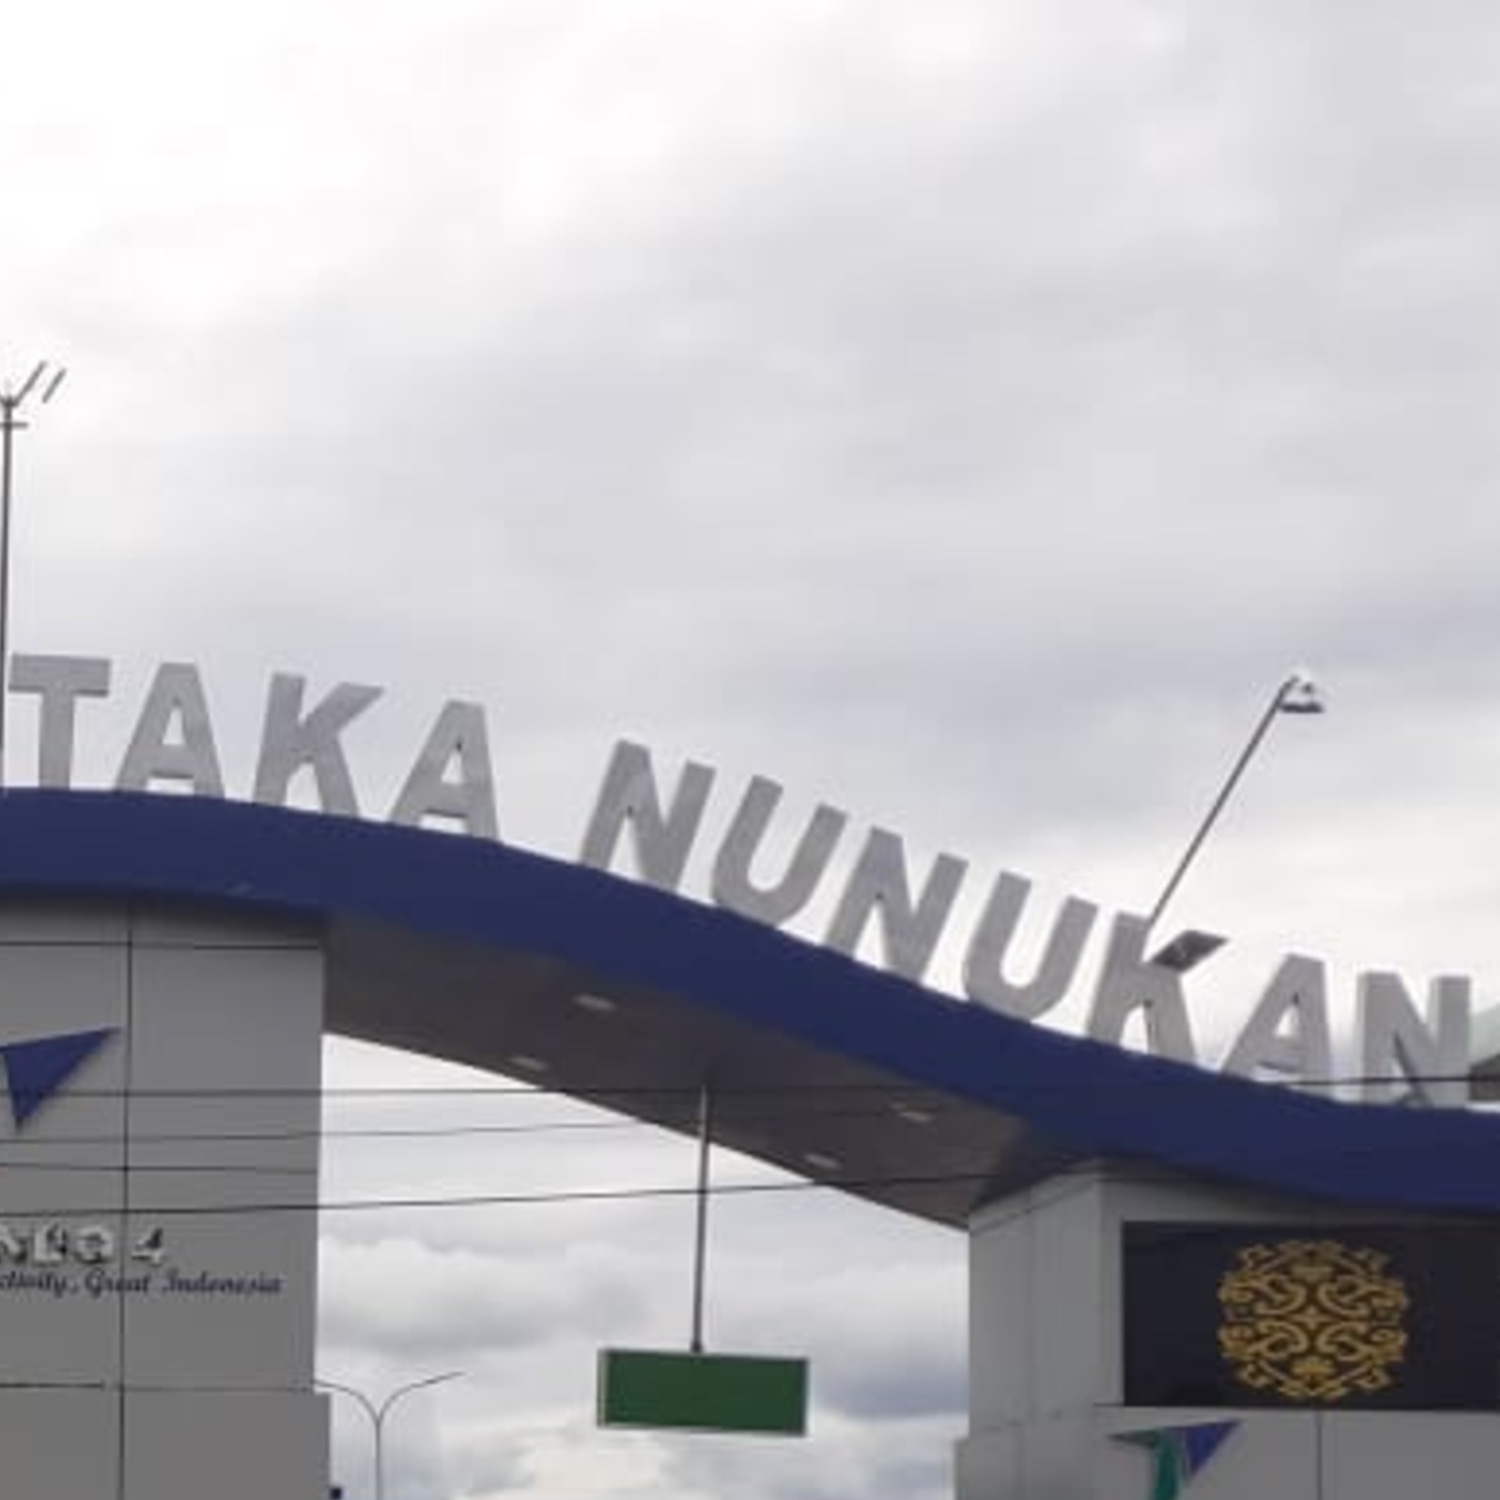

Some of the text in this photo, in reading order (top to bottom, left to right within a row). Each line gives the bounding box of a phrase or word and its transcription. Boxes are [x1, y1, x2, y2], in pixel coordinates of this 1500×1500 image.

[6, 652, 502, 842] TAKA
[577, 738, 1471, 1107] NUNUKAN
[84, 1267, 151, 1298] Great
